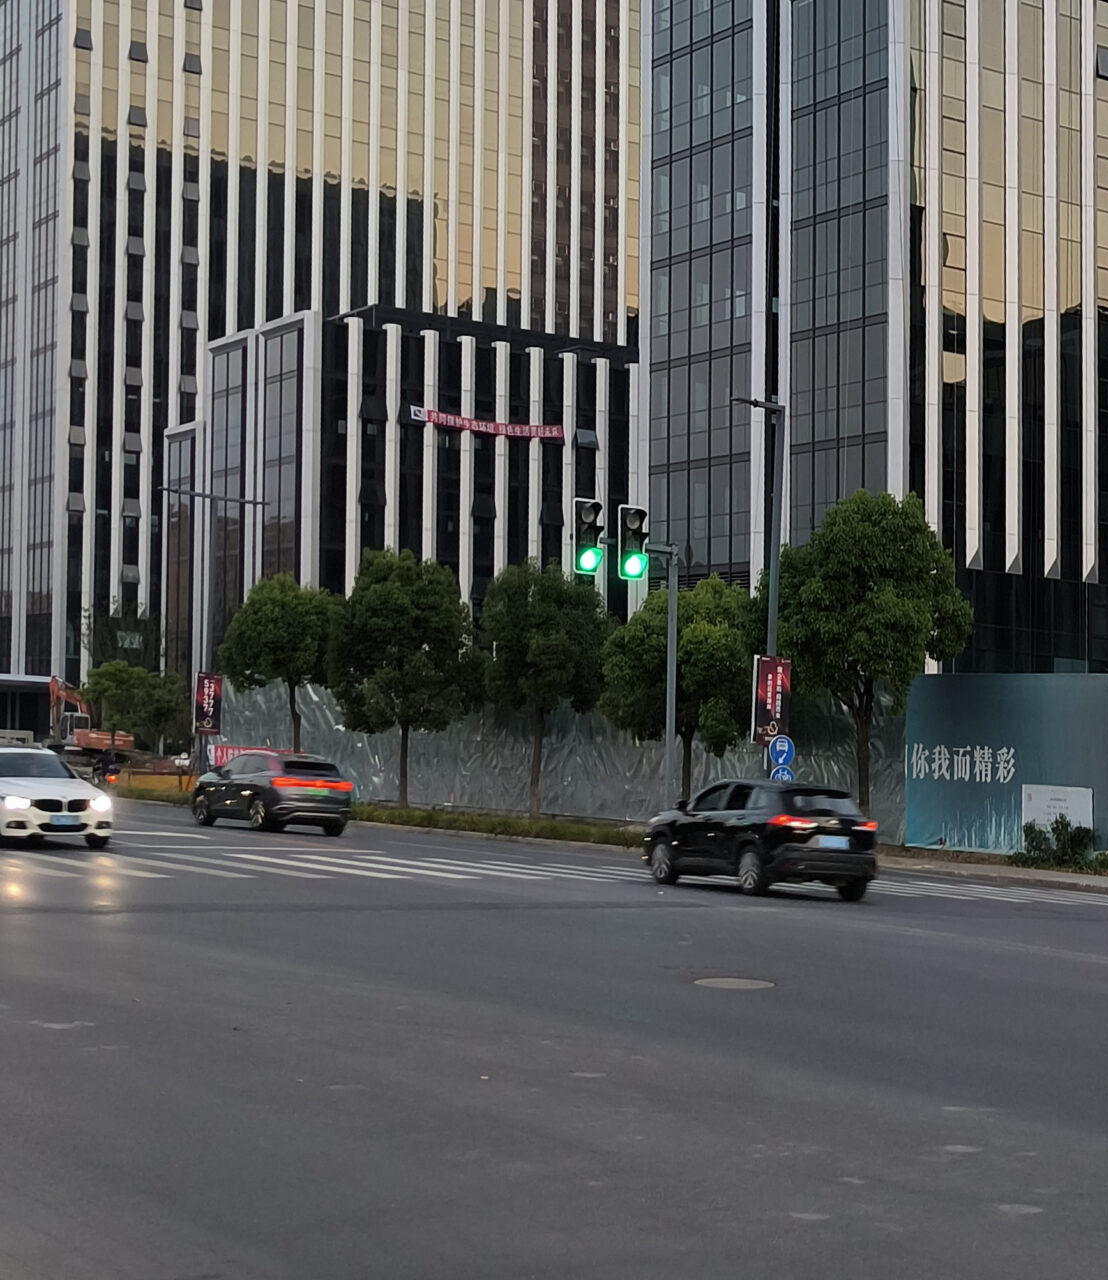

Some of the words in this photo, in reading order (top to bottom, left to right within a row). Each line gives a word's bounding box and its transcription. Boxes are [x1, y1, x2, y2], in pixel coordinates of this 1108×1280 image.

[905, 743, 1016, 784] 你我而精彩
